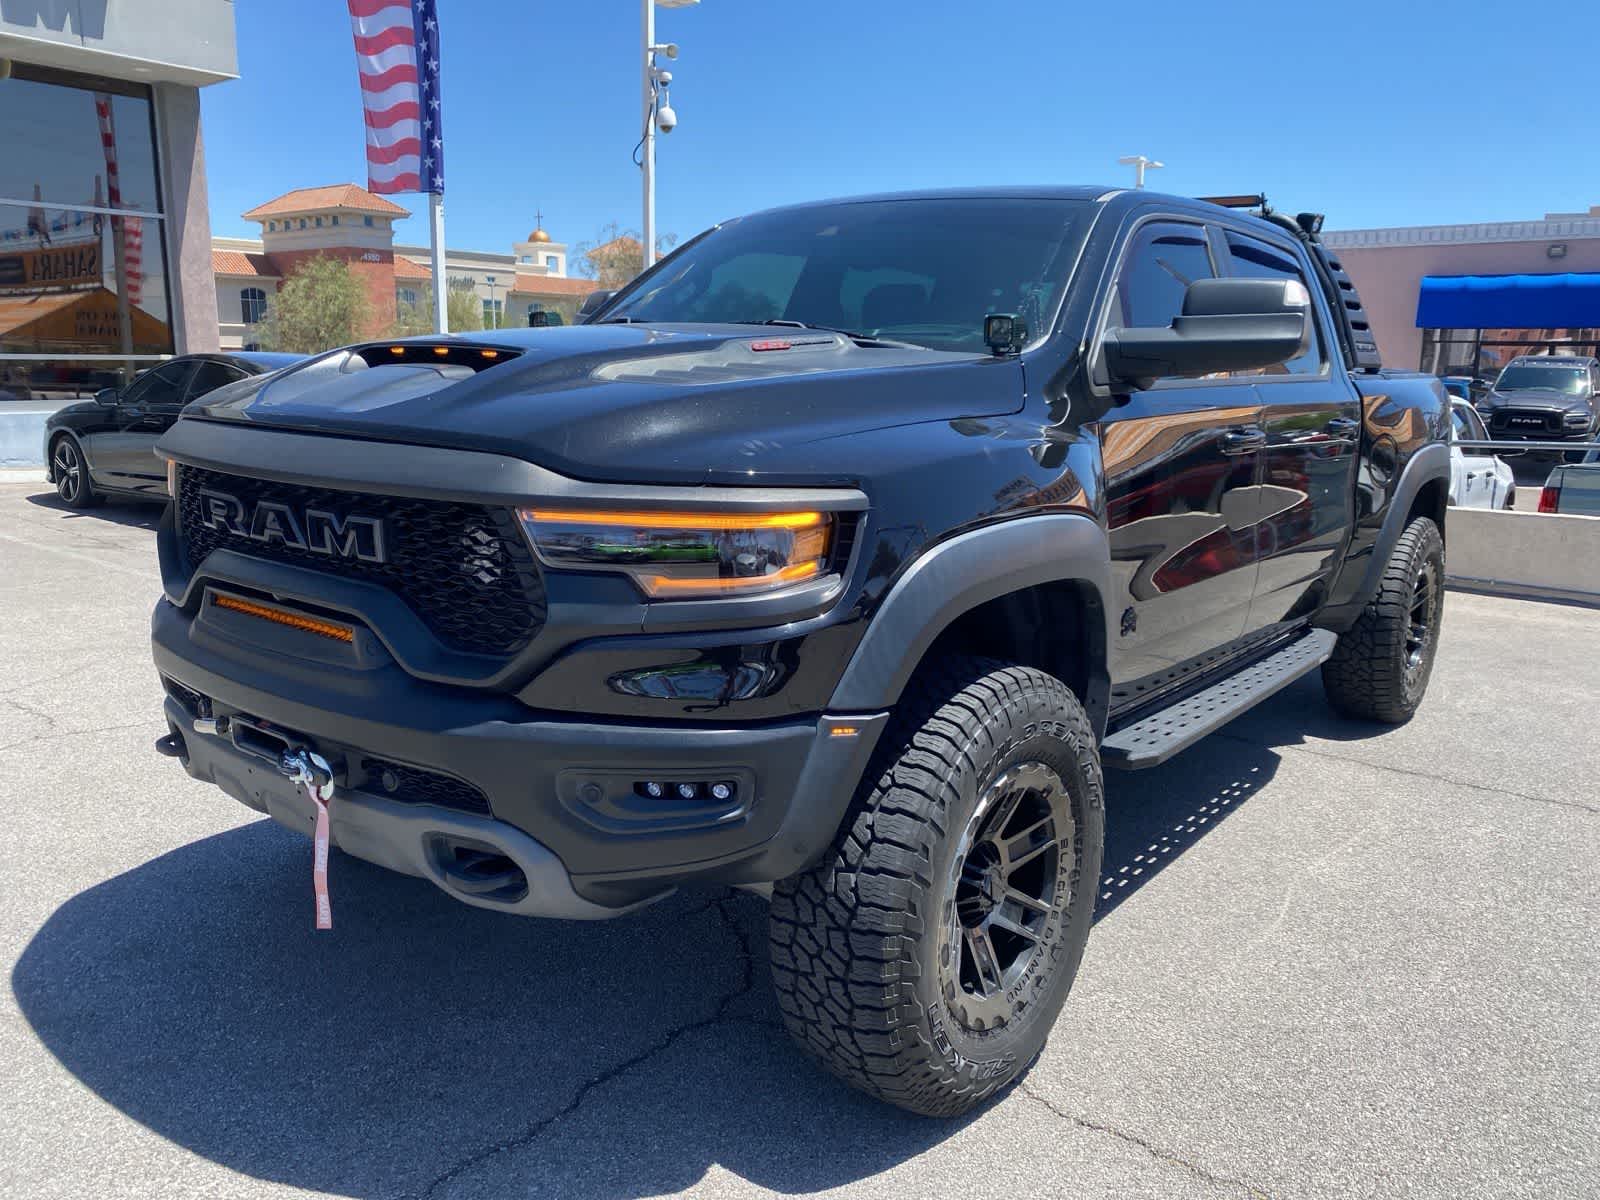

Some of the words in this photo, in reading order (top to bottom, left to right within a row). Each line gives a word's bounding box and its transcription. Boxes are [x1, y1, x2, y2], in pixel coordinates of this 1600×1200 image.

[1512, 417, 1543, 425] RAM
[199, 486, 387, 564] RAM
[1049, 837, 1070, 921] BLAQUE
[1005, 926, 1055, 1004] DIAMOND
